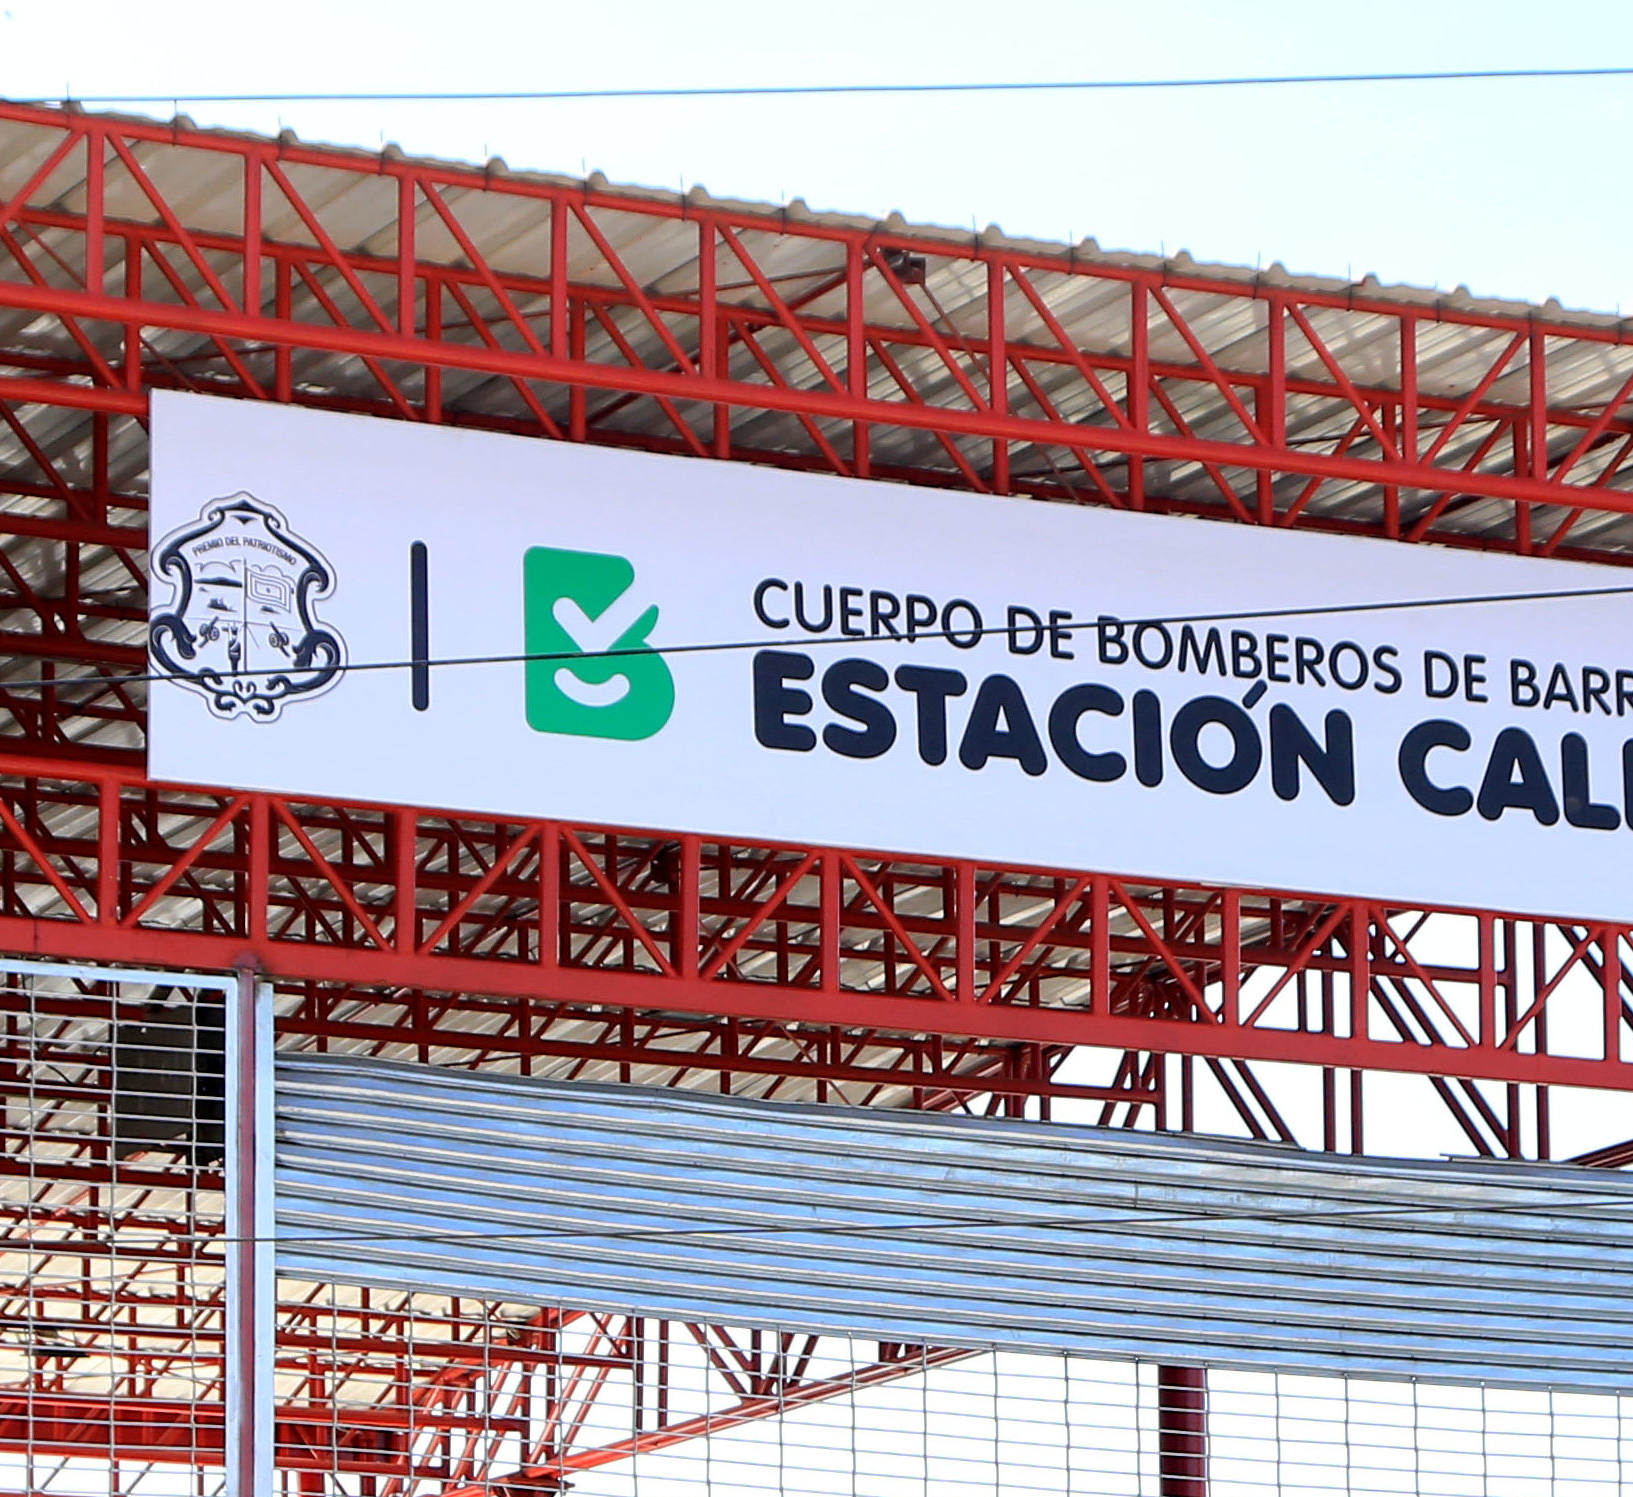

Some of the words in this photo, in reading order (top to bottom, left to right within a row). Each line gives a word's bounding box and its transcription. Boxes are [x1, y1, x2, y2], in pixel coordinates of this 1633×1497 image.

[192, 537, 223, 556] PREMIO
[225, 536, 241, 546] DEL
[243, 536, 297, 566] PATRIOTISMO
[753, 577, 983, 649] CUERPO
[1007, 605, 1074, 660] DE
[1097, 615, 1403, 697] BOMBEROS
[1423, 651, 1488, 705] DE
[752, 650, 1356, 807] ESTACIÓN
